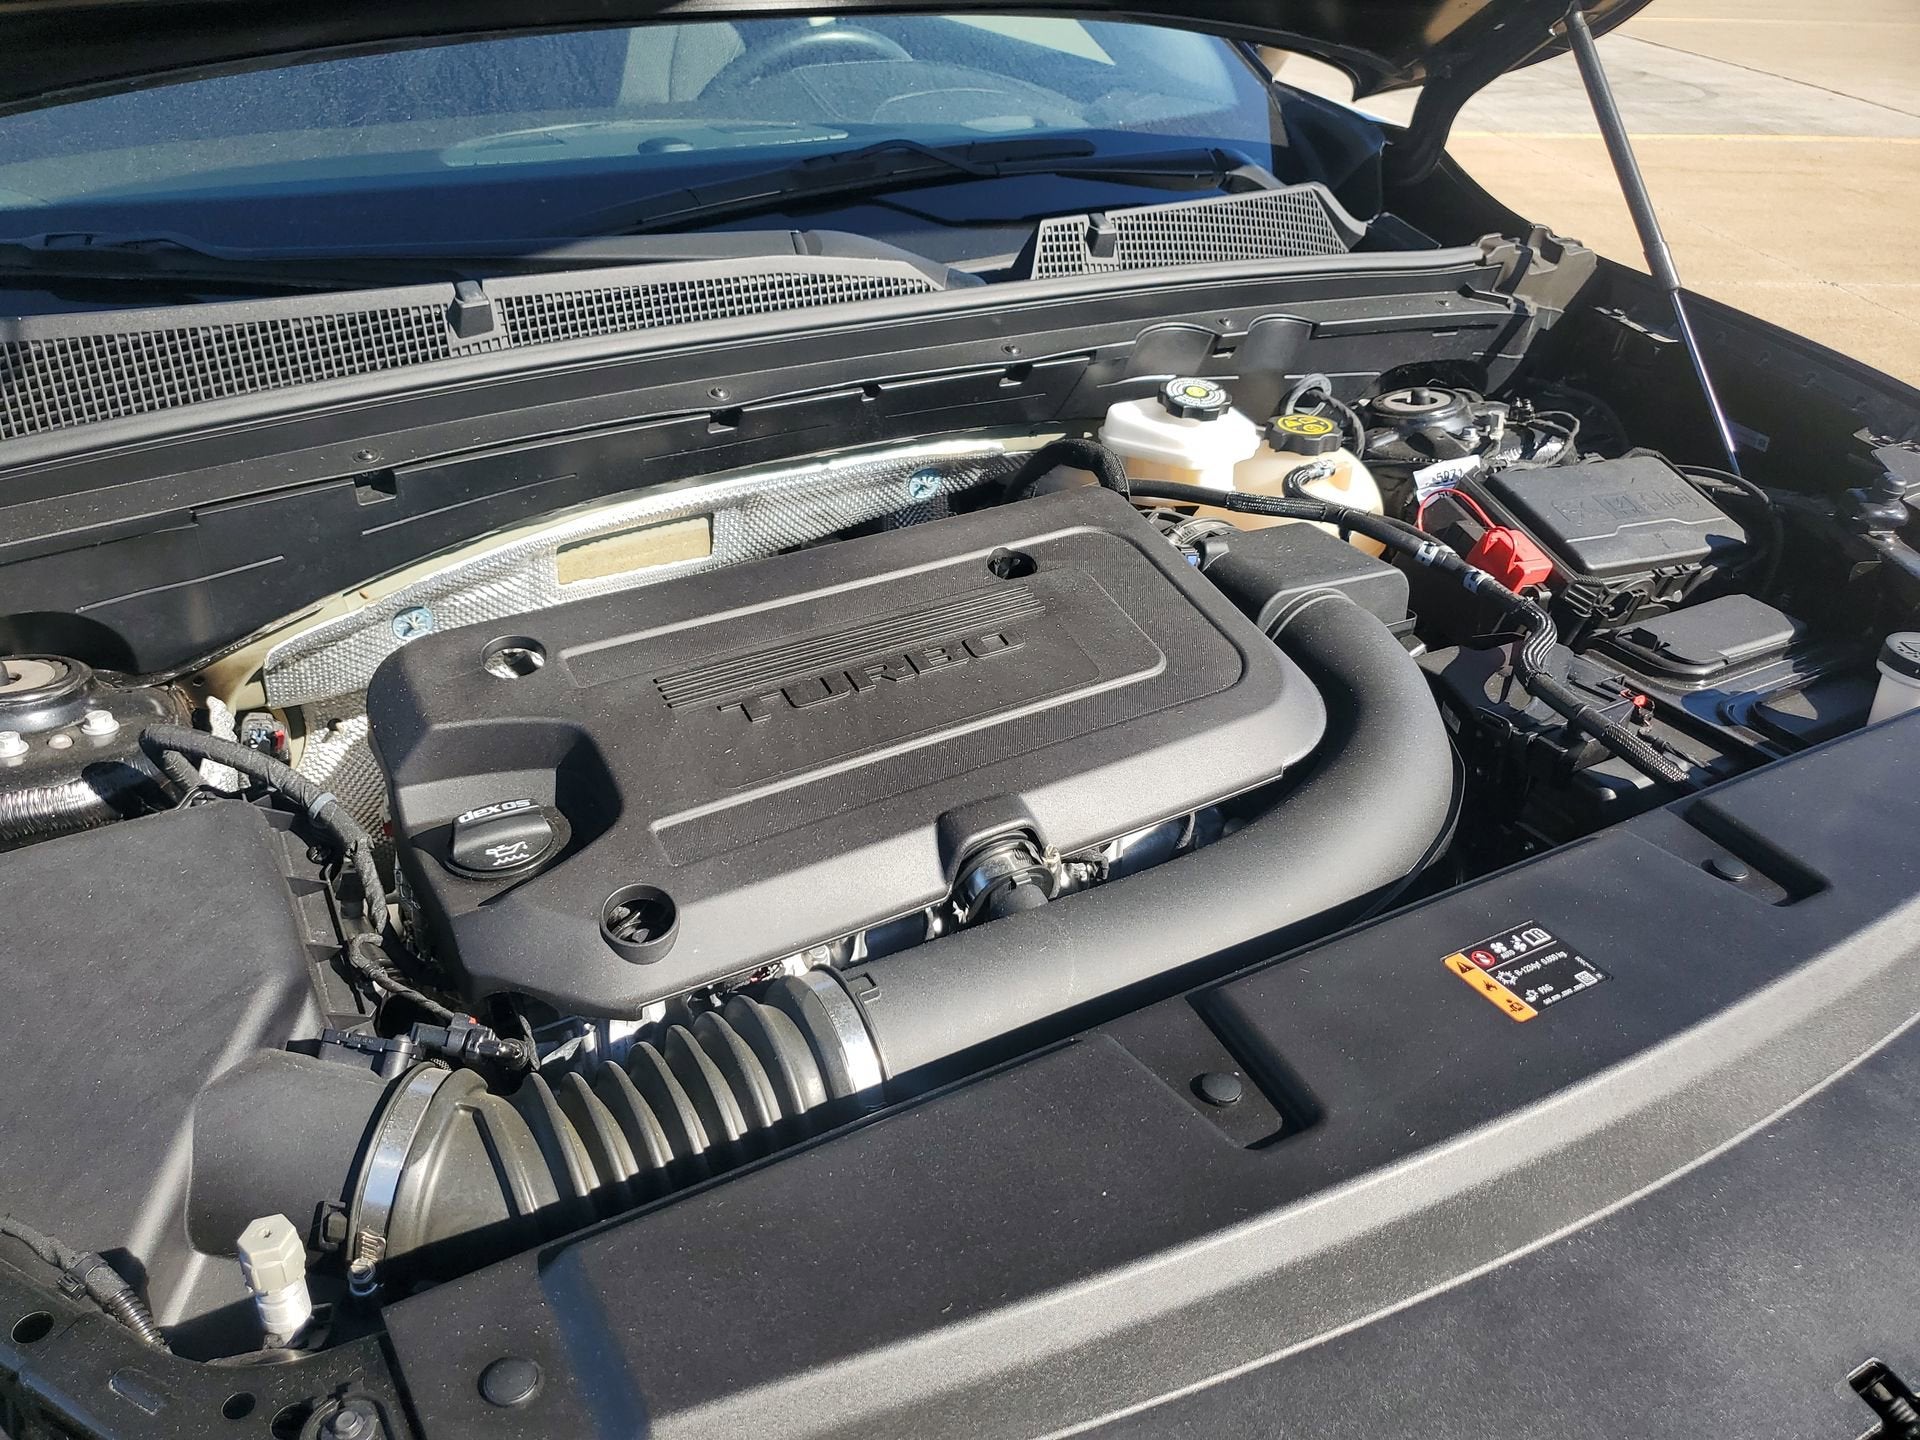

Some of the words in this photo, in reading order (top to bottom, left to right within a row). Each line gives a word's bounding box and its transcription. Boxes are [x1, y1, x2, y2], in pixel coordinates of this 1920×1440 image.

[716, 630, 1026, 723] TURBO
[458, 799, 531, 824] dexos
[1538, 984, 1554, 994] PAG
